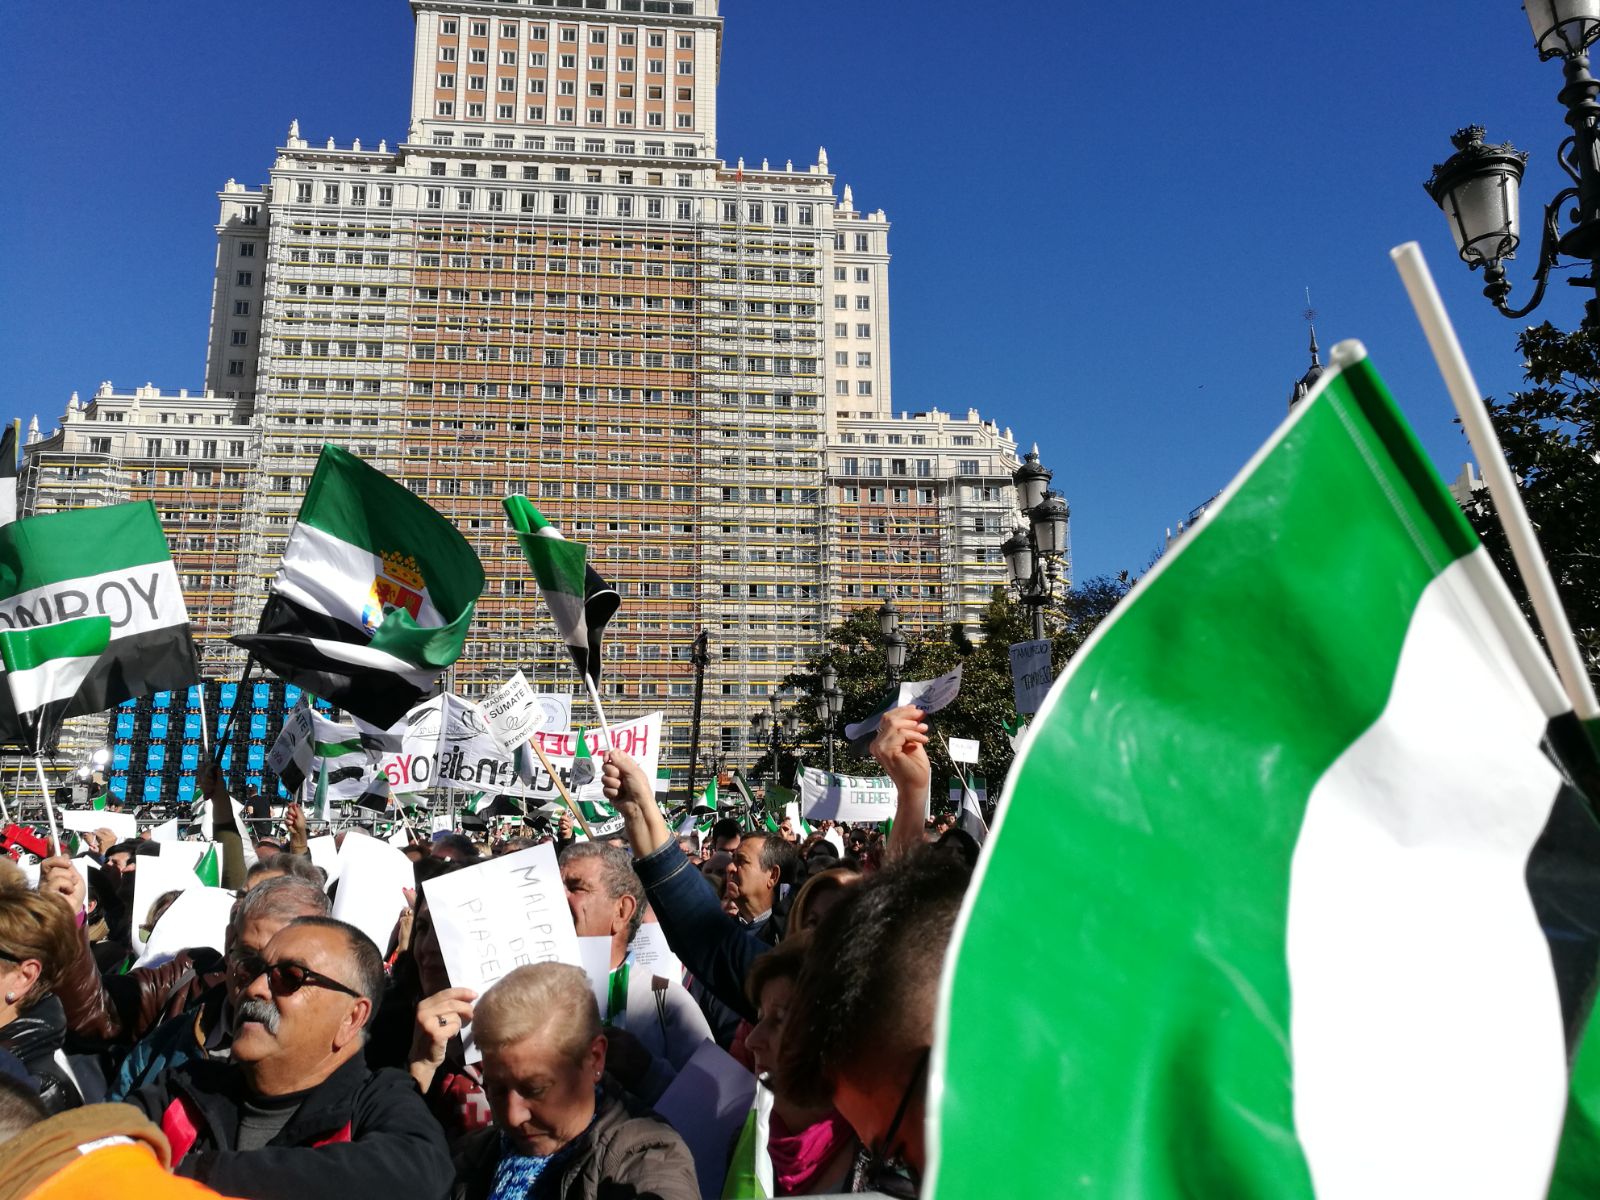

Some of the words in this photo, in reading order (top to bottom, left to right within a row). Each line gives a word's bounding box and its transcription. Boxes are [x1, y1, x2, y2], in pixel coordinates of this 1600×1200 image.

[483, 690, 511, 709] MADRID
[489, 688, 526, 719] SÚMATE
[509, 864, 560, 962] MALPAR
